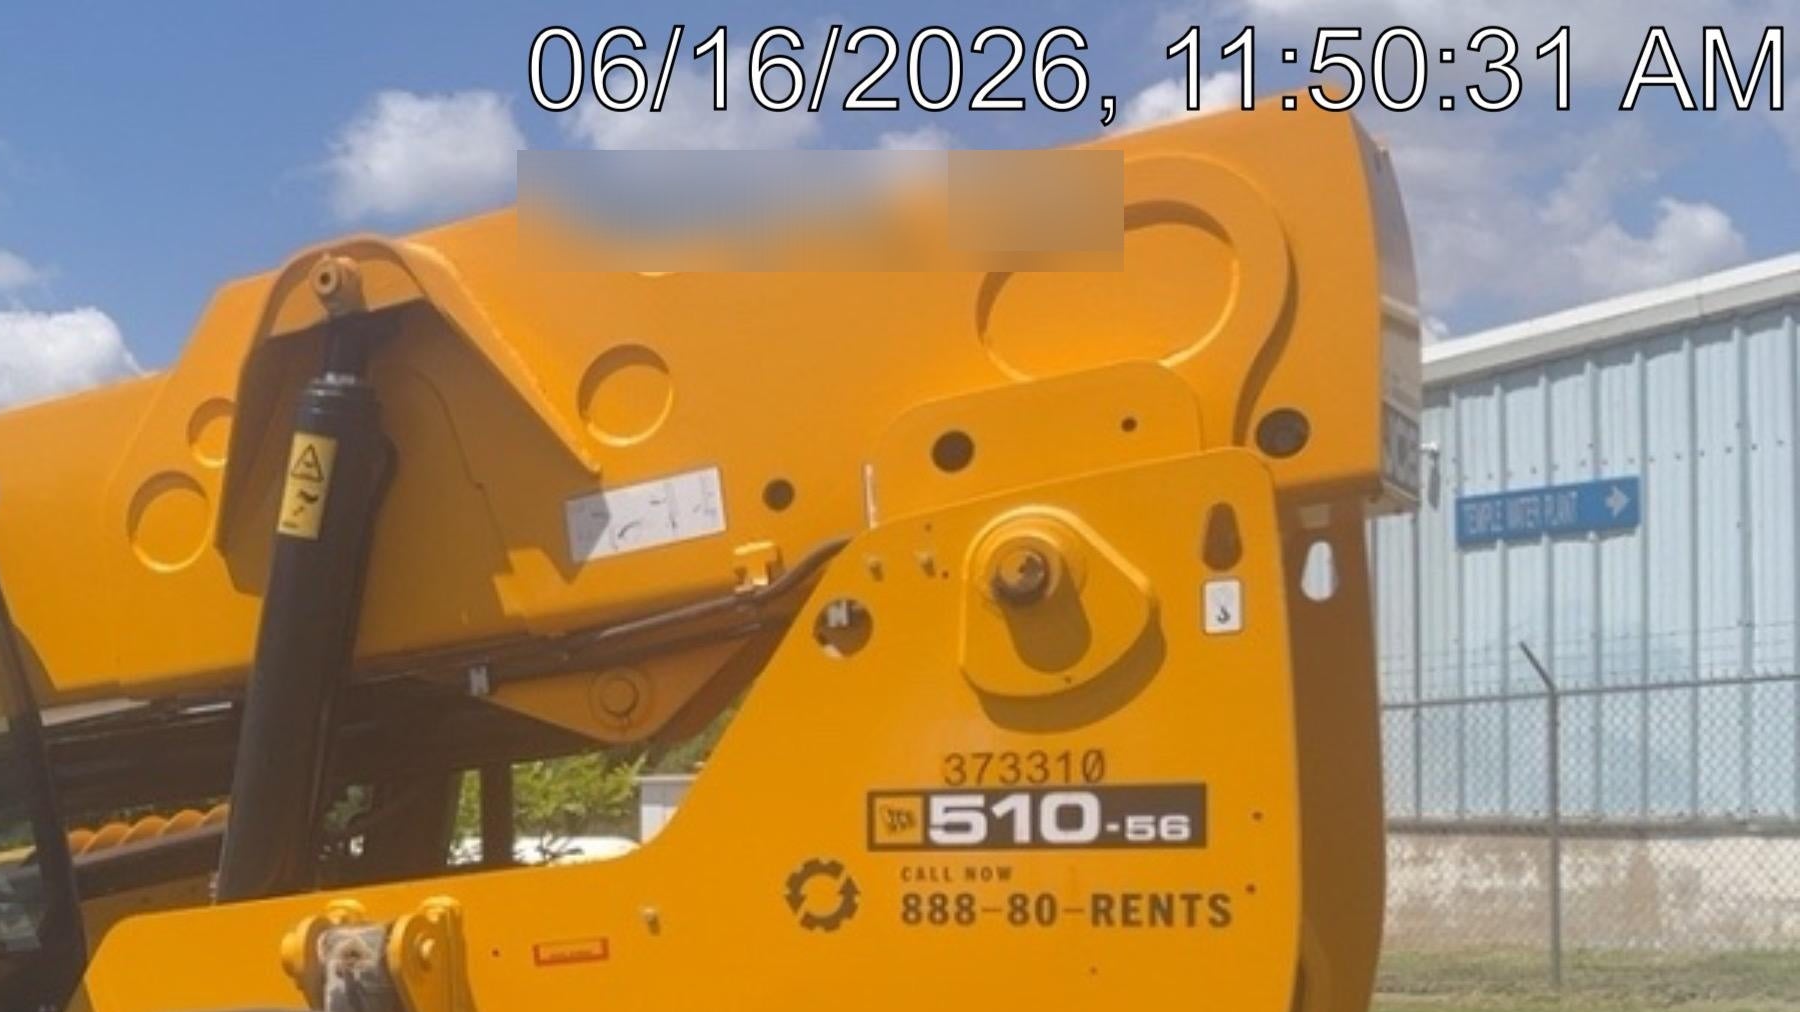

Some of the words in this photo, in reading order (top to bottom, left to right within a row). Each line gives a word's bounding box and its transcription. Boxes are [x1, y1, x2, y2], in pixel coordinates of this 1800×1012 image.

[944, 749, 1106, 787] 373310
[901, 867, 953, 883] CALL
[965, 866, 1012, 882] NOW
[901, 893, 1232, 928] 888-80-RENTS
